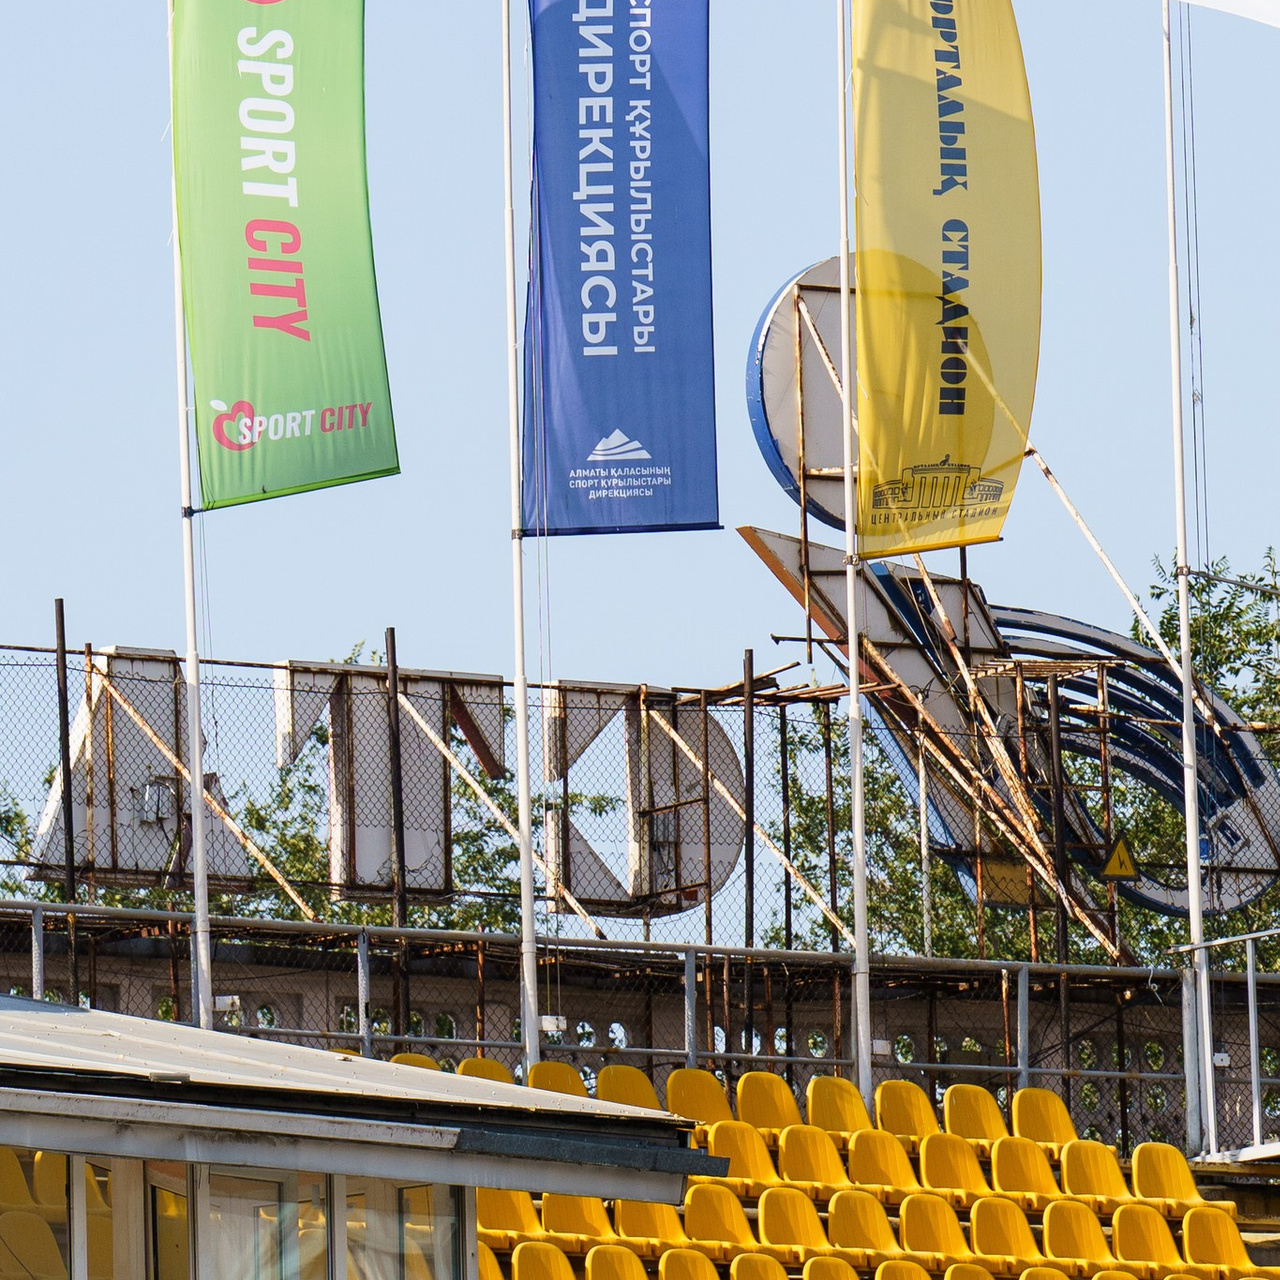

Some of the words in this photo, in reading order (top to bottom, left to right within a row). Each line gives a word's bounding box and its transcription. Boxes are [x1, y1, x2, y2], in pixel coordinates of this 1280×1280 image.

[236, 26, 299, 208] SPORT
[244, 218, 311, 342] CITY
[934, 218, 970, 416] СТАДИОН
[238, 409, 316, 445] SPORT
[320, 402, 373, 433] CITY
[569, 468, 608, 478] АЛМАТЫ
[569, 479, 599, 488] СПОРТ
[588, 488, 653, 499] ДИРЕКЦИЯСЫ
[871, 508, 946, 525] ЦЕНТРАЛЬНЫЙ
[951, 506, 997, 519] СТАДИОН
